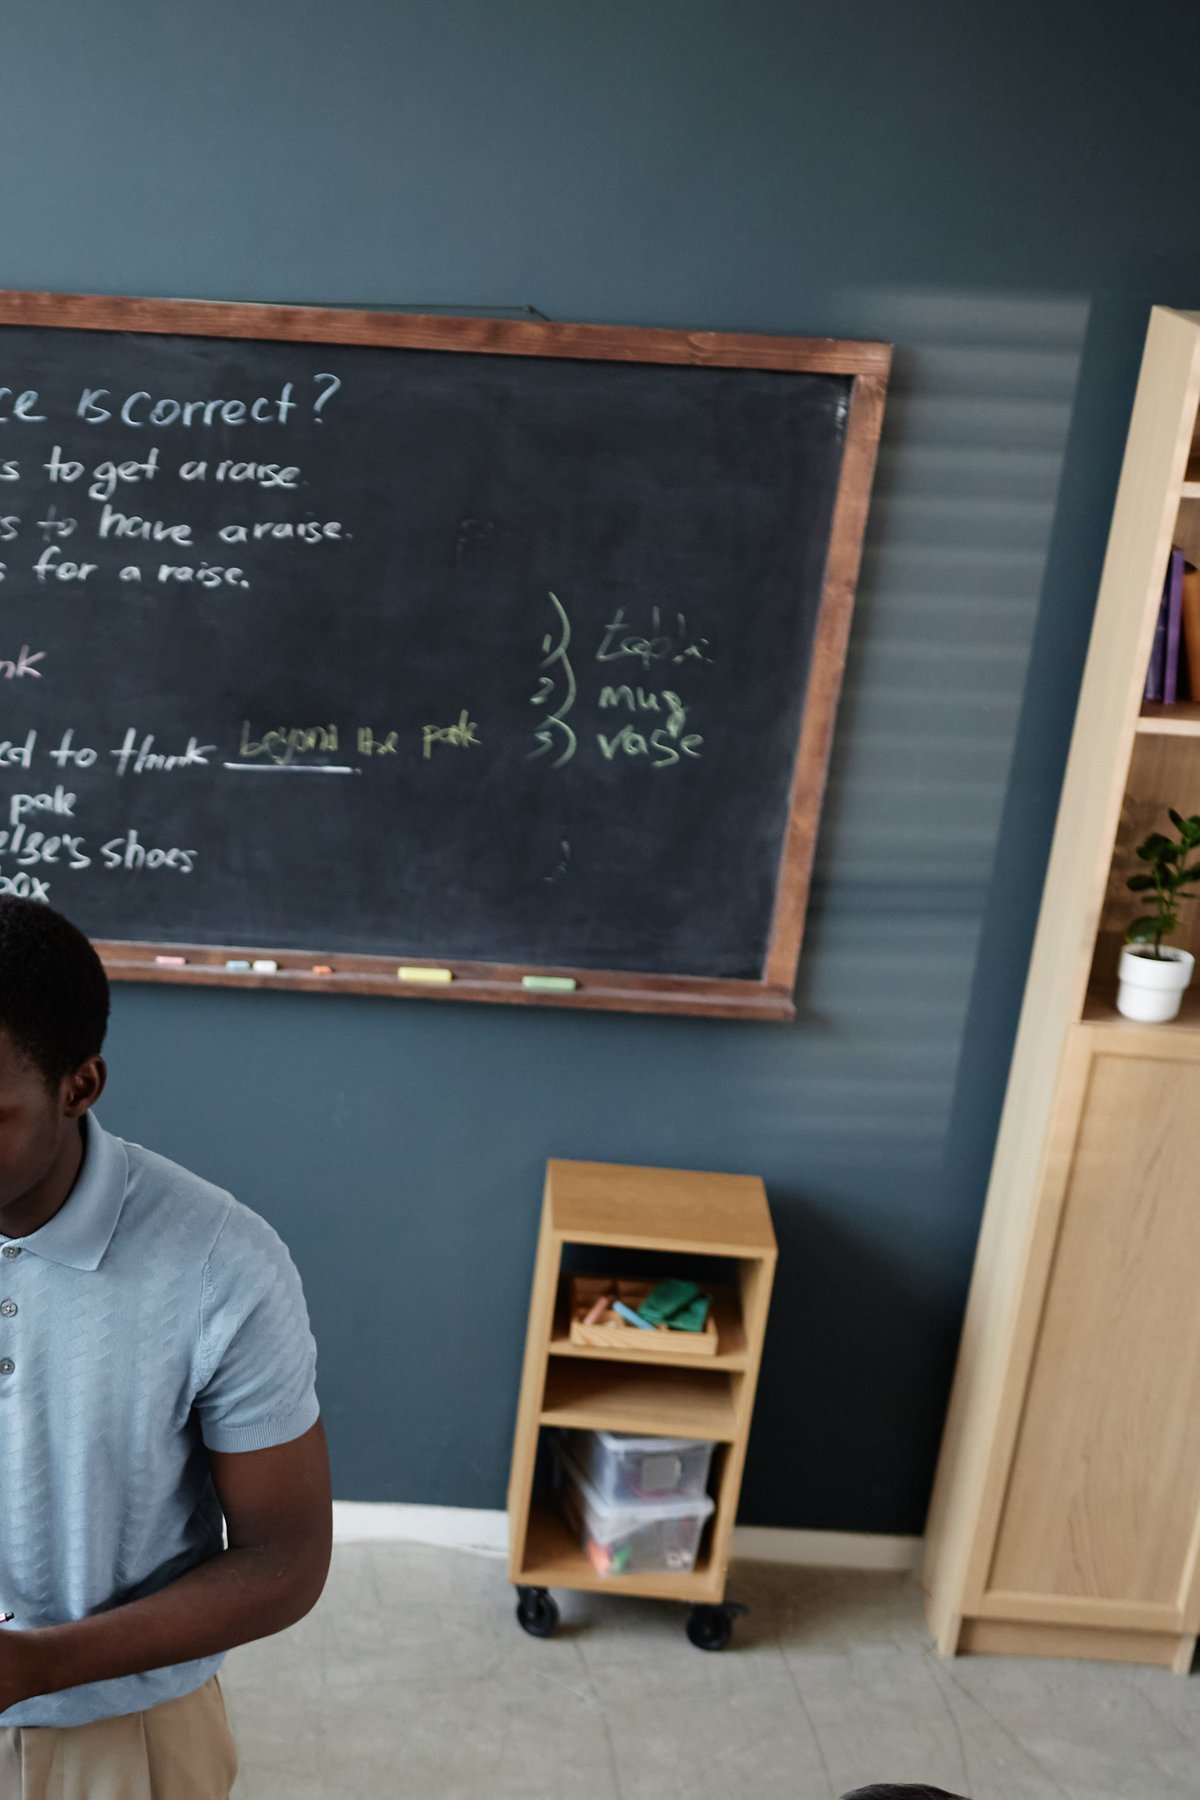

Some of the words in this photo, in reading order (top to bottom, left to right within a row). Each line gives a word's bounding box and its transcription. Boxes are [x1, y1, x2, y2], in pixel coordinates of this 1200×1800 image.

[77, 388, 111, 424] is
[44, 446, 84, 483] to
[88, 447, 159, 500] get
[179, 461, 207, 481] a
[36, 505, 77, 541] to
[99, 504, 194, 546] have
[218, 525, 248, 543] a
[33, 545, 98, 582] for
[119, 566, 142, 582] a
[599, 684, 688, 738] mug
[50, 728, 98, 767] to
[109, 727, 217, 776] think
[10, 784, 77, 825] pale
[101, 829, 199, 873] shoes
